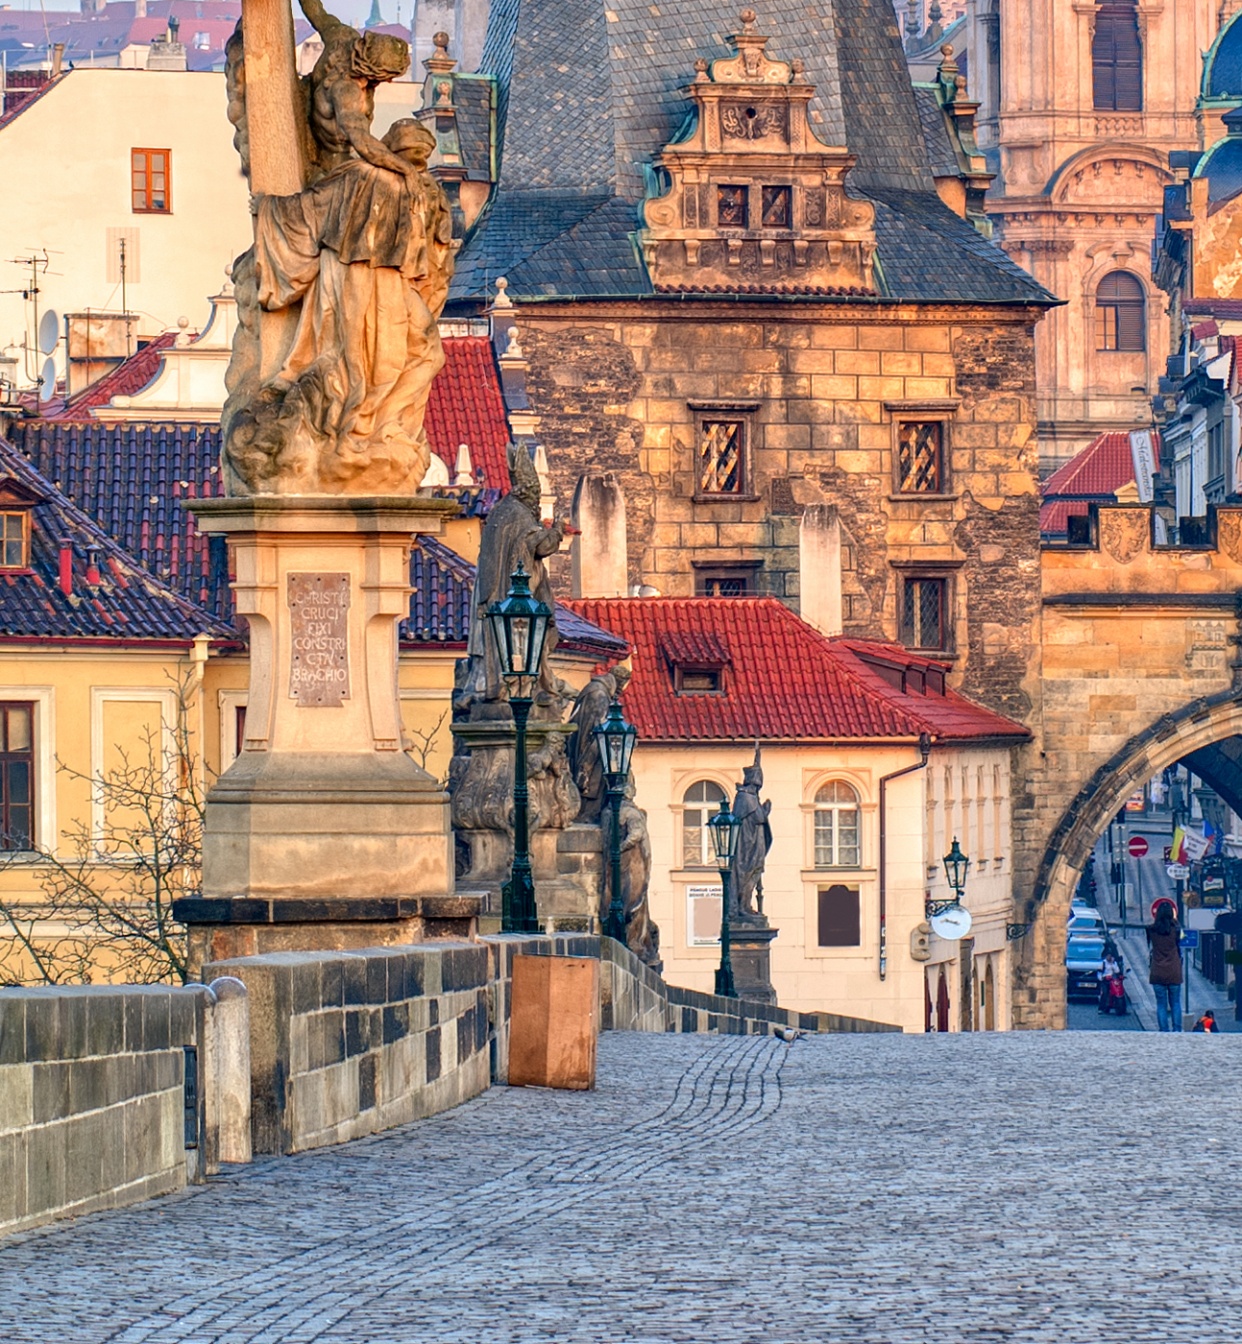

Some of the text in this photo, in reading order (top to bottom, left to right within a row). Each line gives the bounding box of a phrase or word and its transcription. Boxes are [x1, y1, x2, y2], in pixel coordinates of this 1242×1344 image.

[295, 591, 344, 605] CHRISTI
[301, 607, 339, 620] CRUCI
[294, 637, 345, 650] CONSTRI
